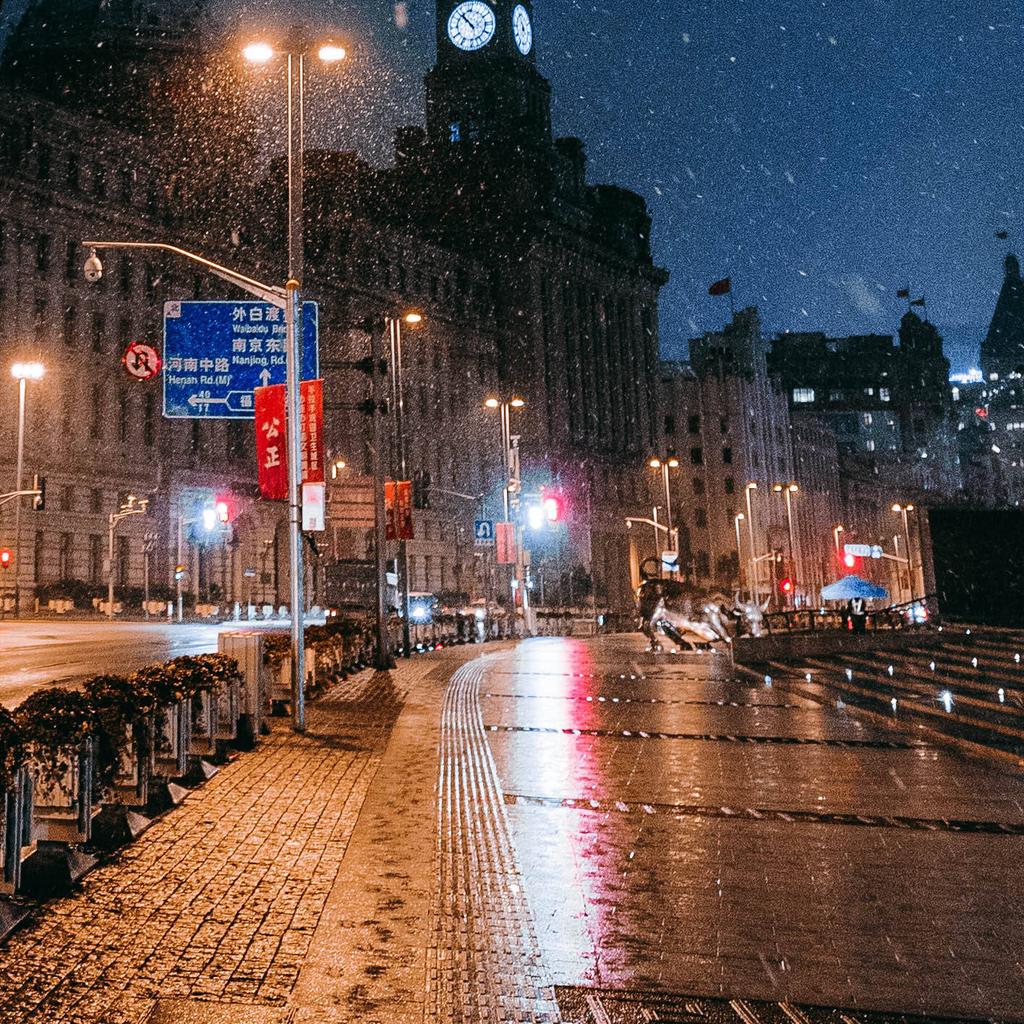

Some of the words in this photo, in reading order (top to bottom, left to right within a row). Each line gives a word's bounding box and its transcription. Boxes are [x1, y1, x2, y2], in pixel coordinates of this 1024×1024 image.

[232, 307, 287, 322] 外白渡
[168, 357, 230, 373] 河南中路
[168, 375, 198, 385] Henan
[261, 416, 281, 469] 公正
